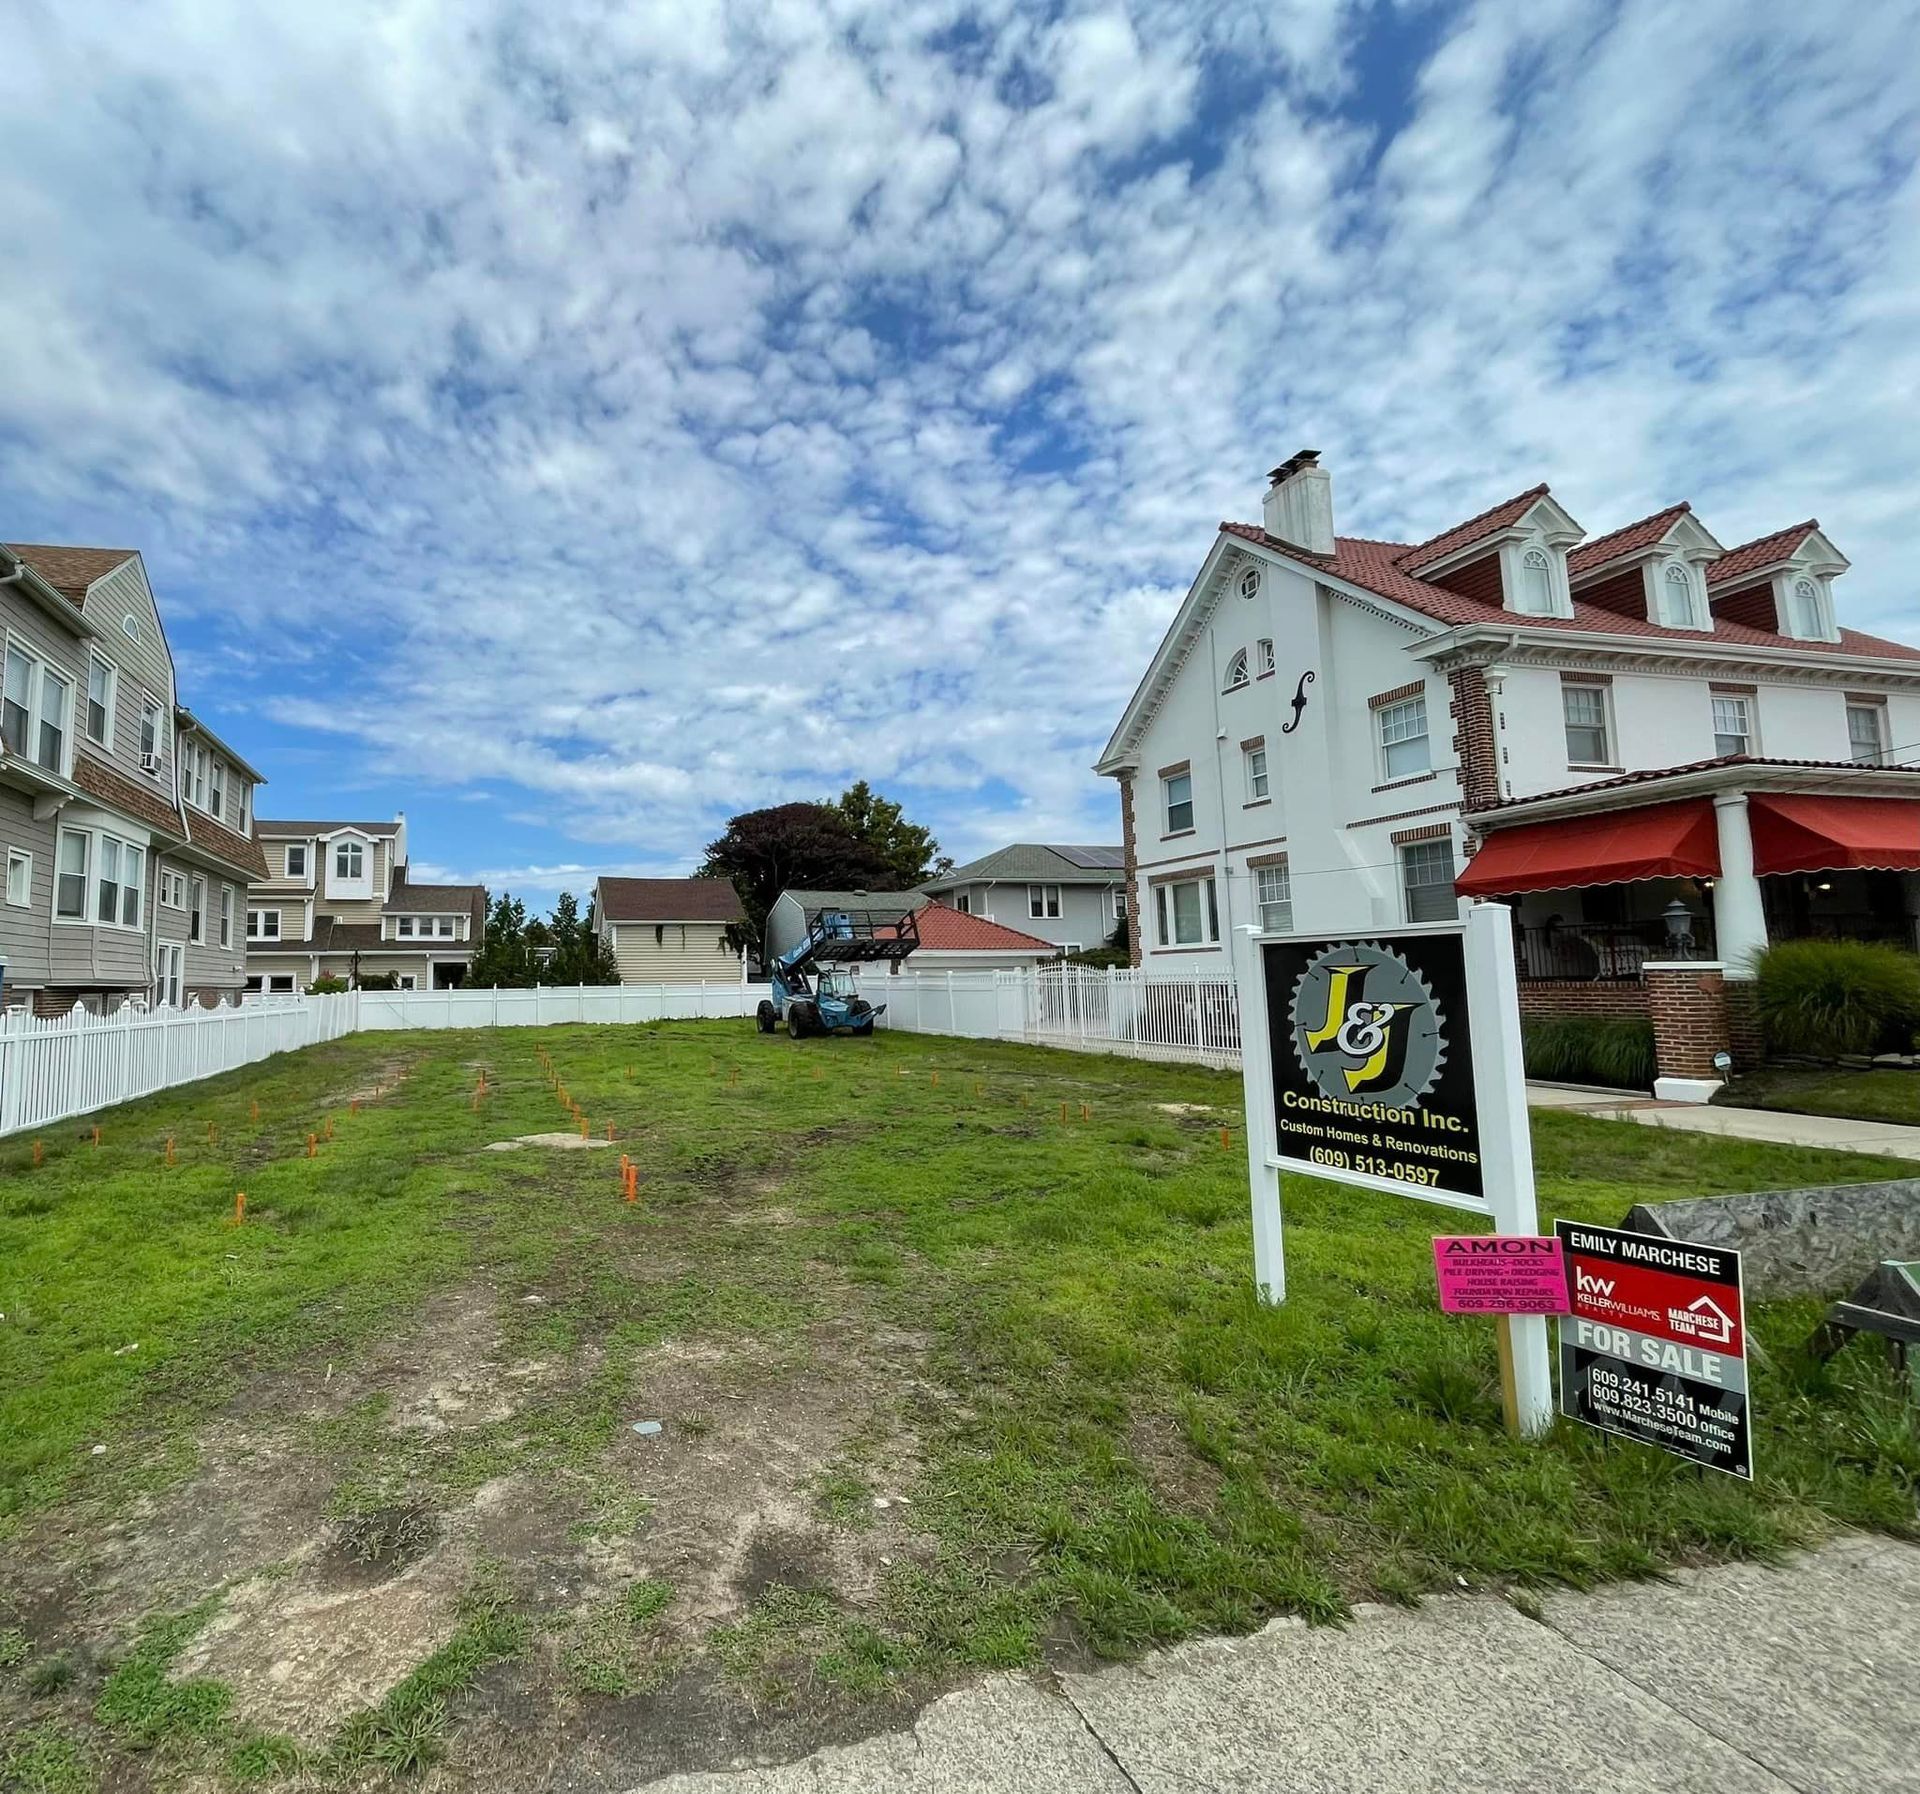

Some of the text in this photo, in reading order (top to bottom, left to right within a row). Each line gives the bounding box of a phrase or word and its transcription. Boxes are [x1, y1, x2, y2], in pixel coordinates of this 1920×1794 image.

[1283, 1091, 1469, 1133] Construction Inc.
[1280, 1118, 1478, 1164] Custom Homes & Renovations
[1309, 1145, 1440, 1187] (609) 513-0597
[1445, 1240, 1554, 1254] AMON
[1571, 1231, 1721, 1275] EMILY MARCHESE
[1443, 1268, 1463, 1276] PILE
[1464, 1268, 1504, 1276] DRIVING
[1511, 1268, 1559, 1277] DREDGING
[1467, 1278, 1538, 1286] HOUSE RAISING
[1576, 1265, 1616, 1297] kw
[1454, 1288, 1554, 1296] FOUNDATION REPAIRS
[1577, 1302, 1624, 1319] REALTY
[1668, 1308, 1719, 1330] MARCHESE
[1669, 1319, 1695, 1336] TEAM
[1577, 1320, 1722, 1383] FOR SALE
[1592, 1368, 1739, 1425] 609.241.5141 Mobile
[1592, 1384, 1697, 1429] 609.823.3500
[1700, 1421, 1735, 1441] Office
[1593, 1401, 1732, 1455] www.MarcheseTeam.com
